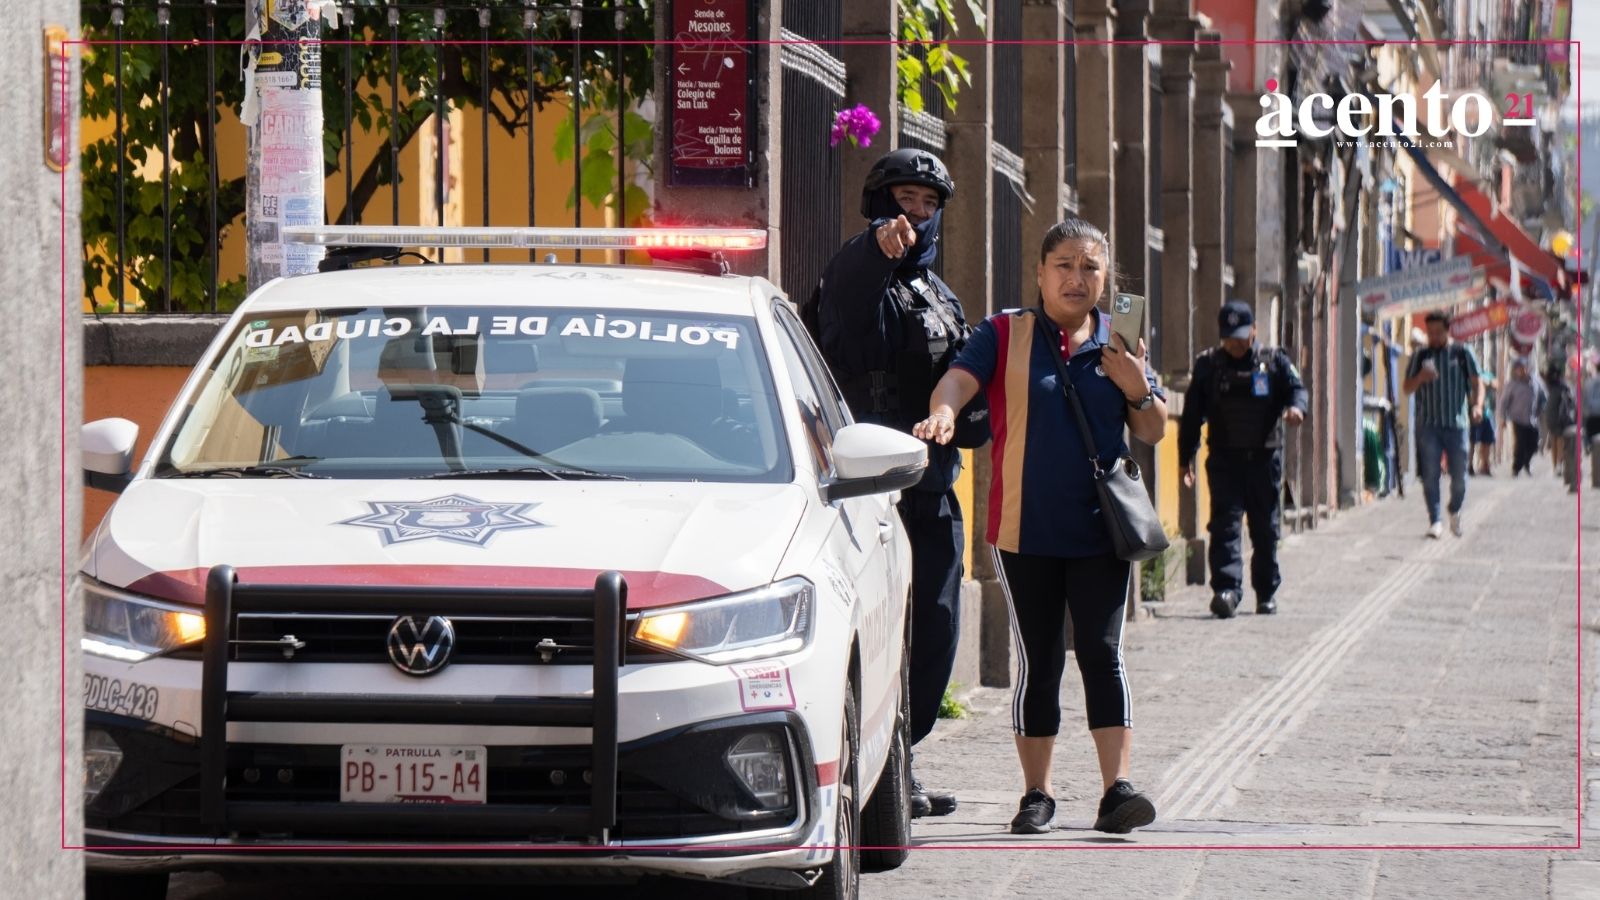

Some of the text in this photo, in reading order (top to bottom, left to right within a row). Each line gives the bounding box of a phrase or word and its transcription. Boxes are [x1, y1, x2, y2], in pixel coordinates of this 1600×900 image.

[694, 9, 725, 18] Senda de
[688, 20, 731, 33] Mesones
[677, 80, 693, 88] Hacia
[698, 80, 720, 88] Towards
[677, 89, 716, 100] Colegio de
[677, 100, 708, 109] San Luis
[699, 126, 715, 134] Hacia
[719, 126, 742, 134] Towards
[705, 135, 742, 146] Capilla de
[714, 145, 742, 155] Dolores
[385, 748, 441, 758] PATRULLA
[345, 761, 480, 793] PB-115-A4
